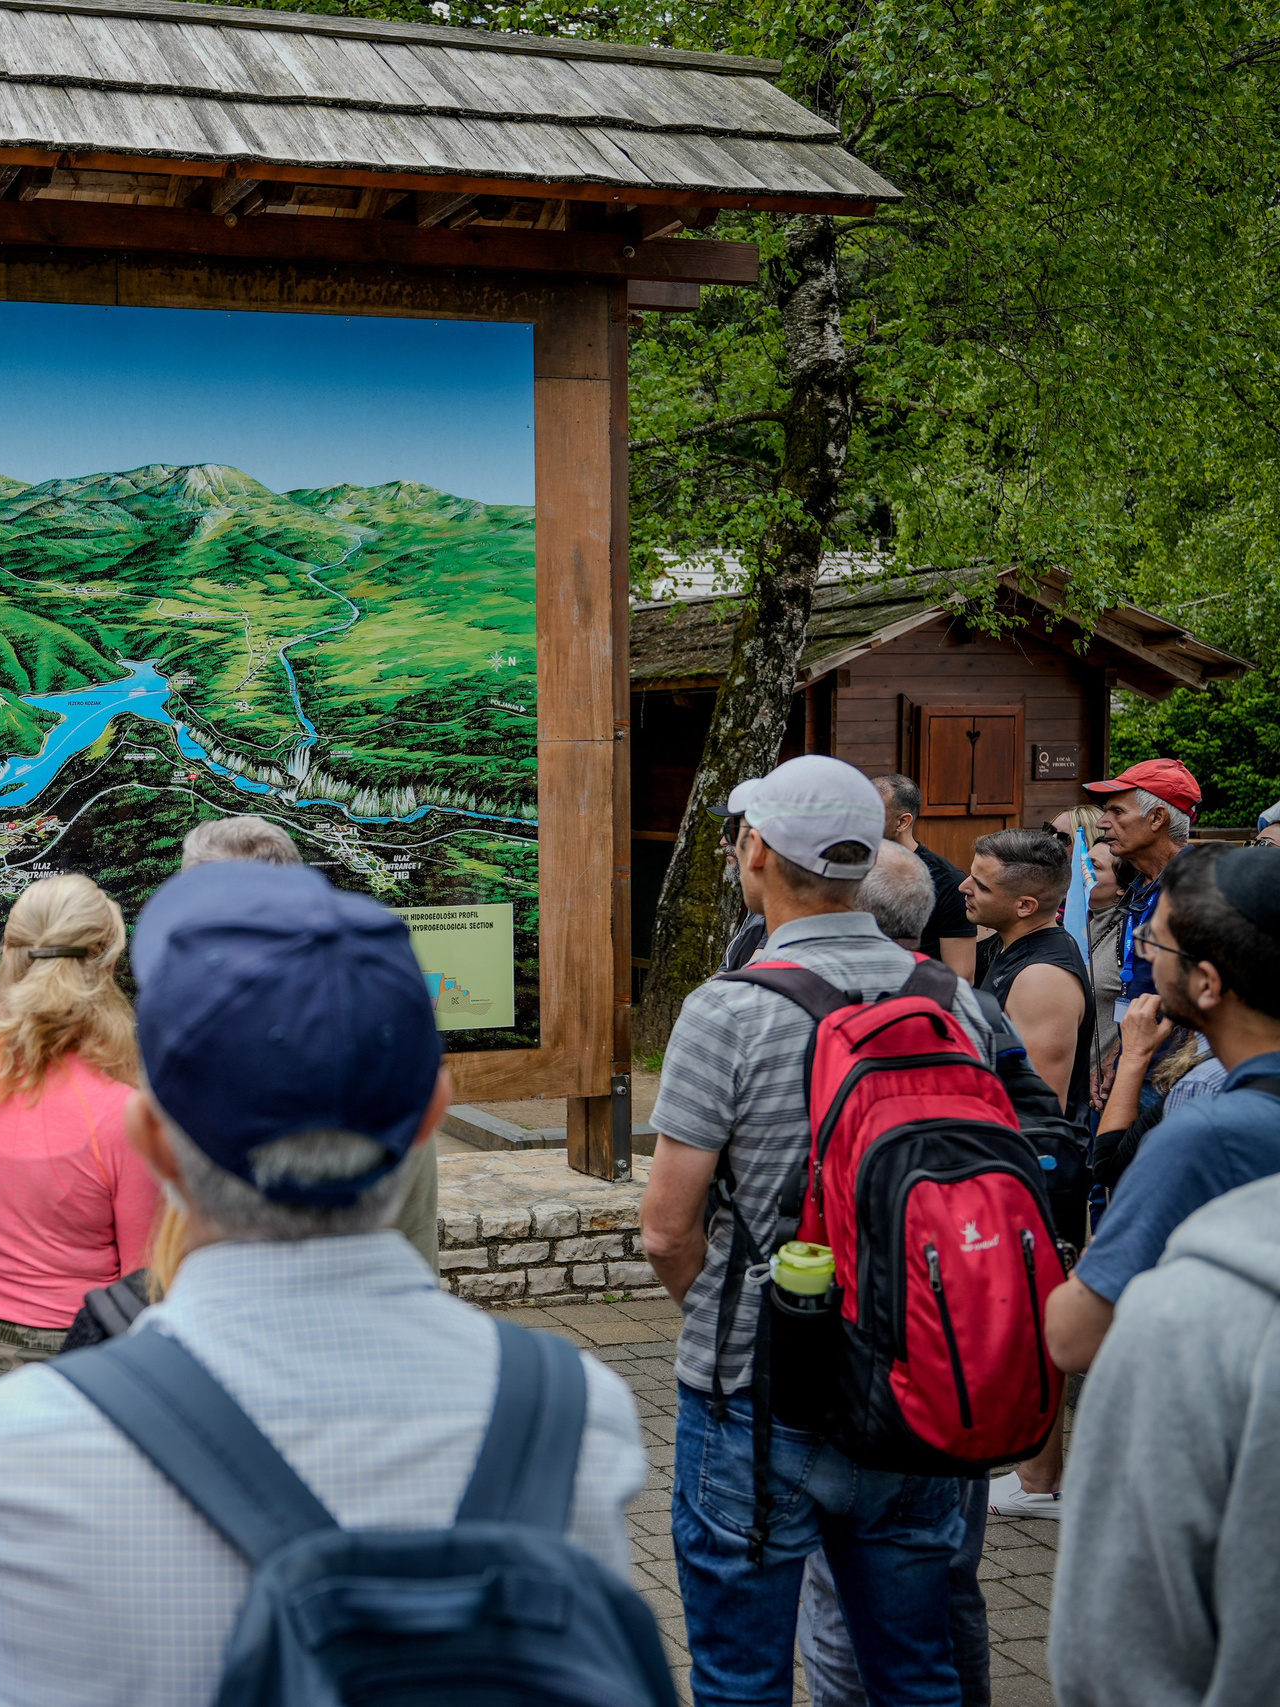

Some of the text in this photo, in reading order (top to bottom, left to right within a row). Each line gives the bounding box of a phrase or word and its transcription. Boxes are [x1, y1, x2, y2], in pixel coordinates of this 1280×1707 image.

[508, 656, 517, 667] N
[32, 862, 51, 870] ULAZ
[382, 862, 417, 870] ENTRANCE
[21, 870, 58, 879] NTRANCE
[410, 911, 458, 920] HIDROGEOLOŠKI
[458, 911, 479, 919] PROFIL
[412, 923, 468, 932] HYDROGEOLOGICAL
[469, 921, 494, 930] SECTION
